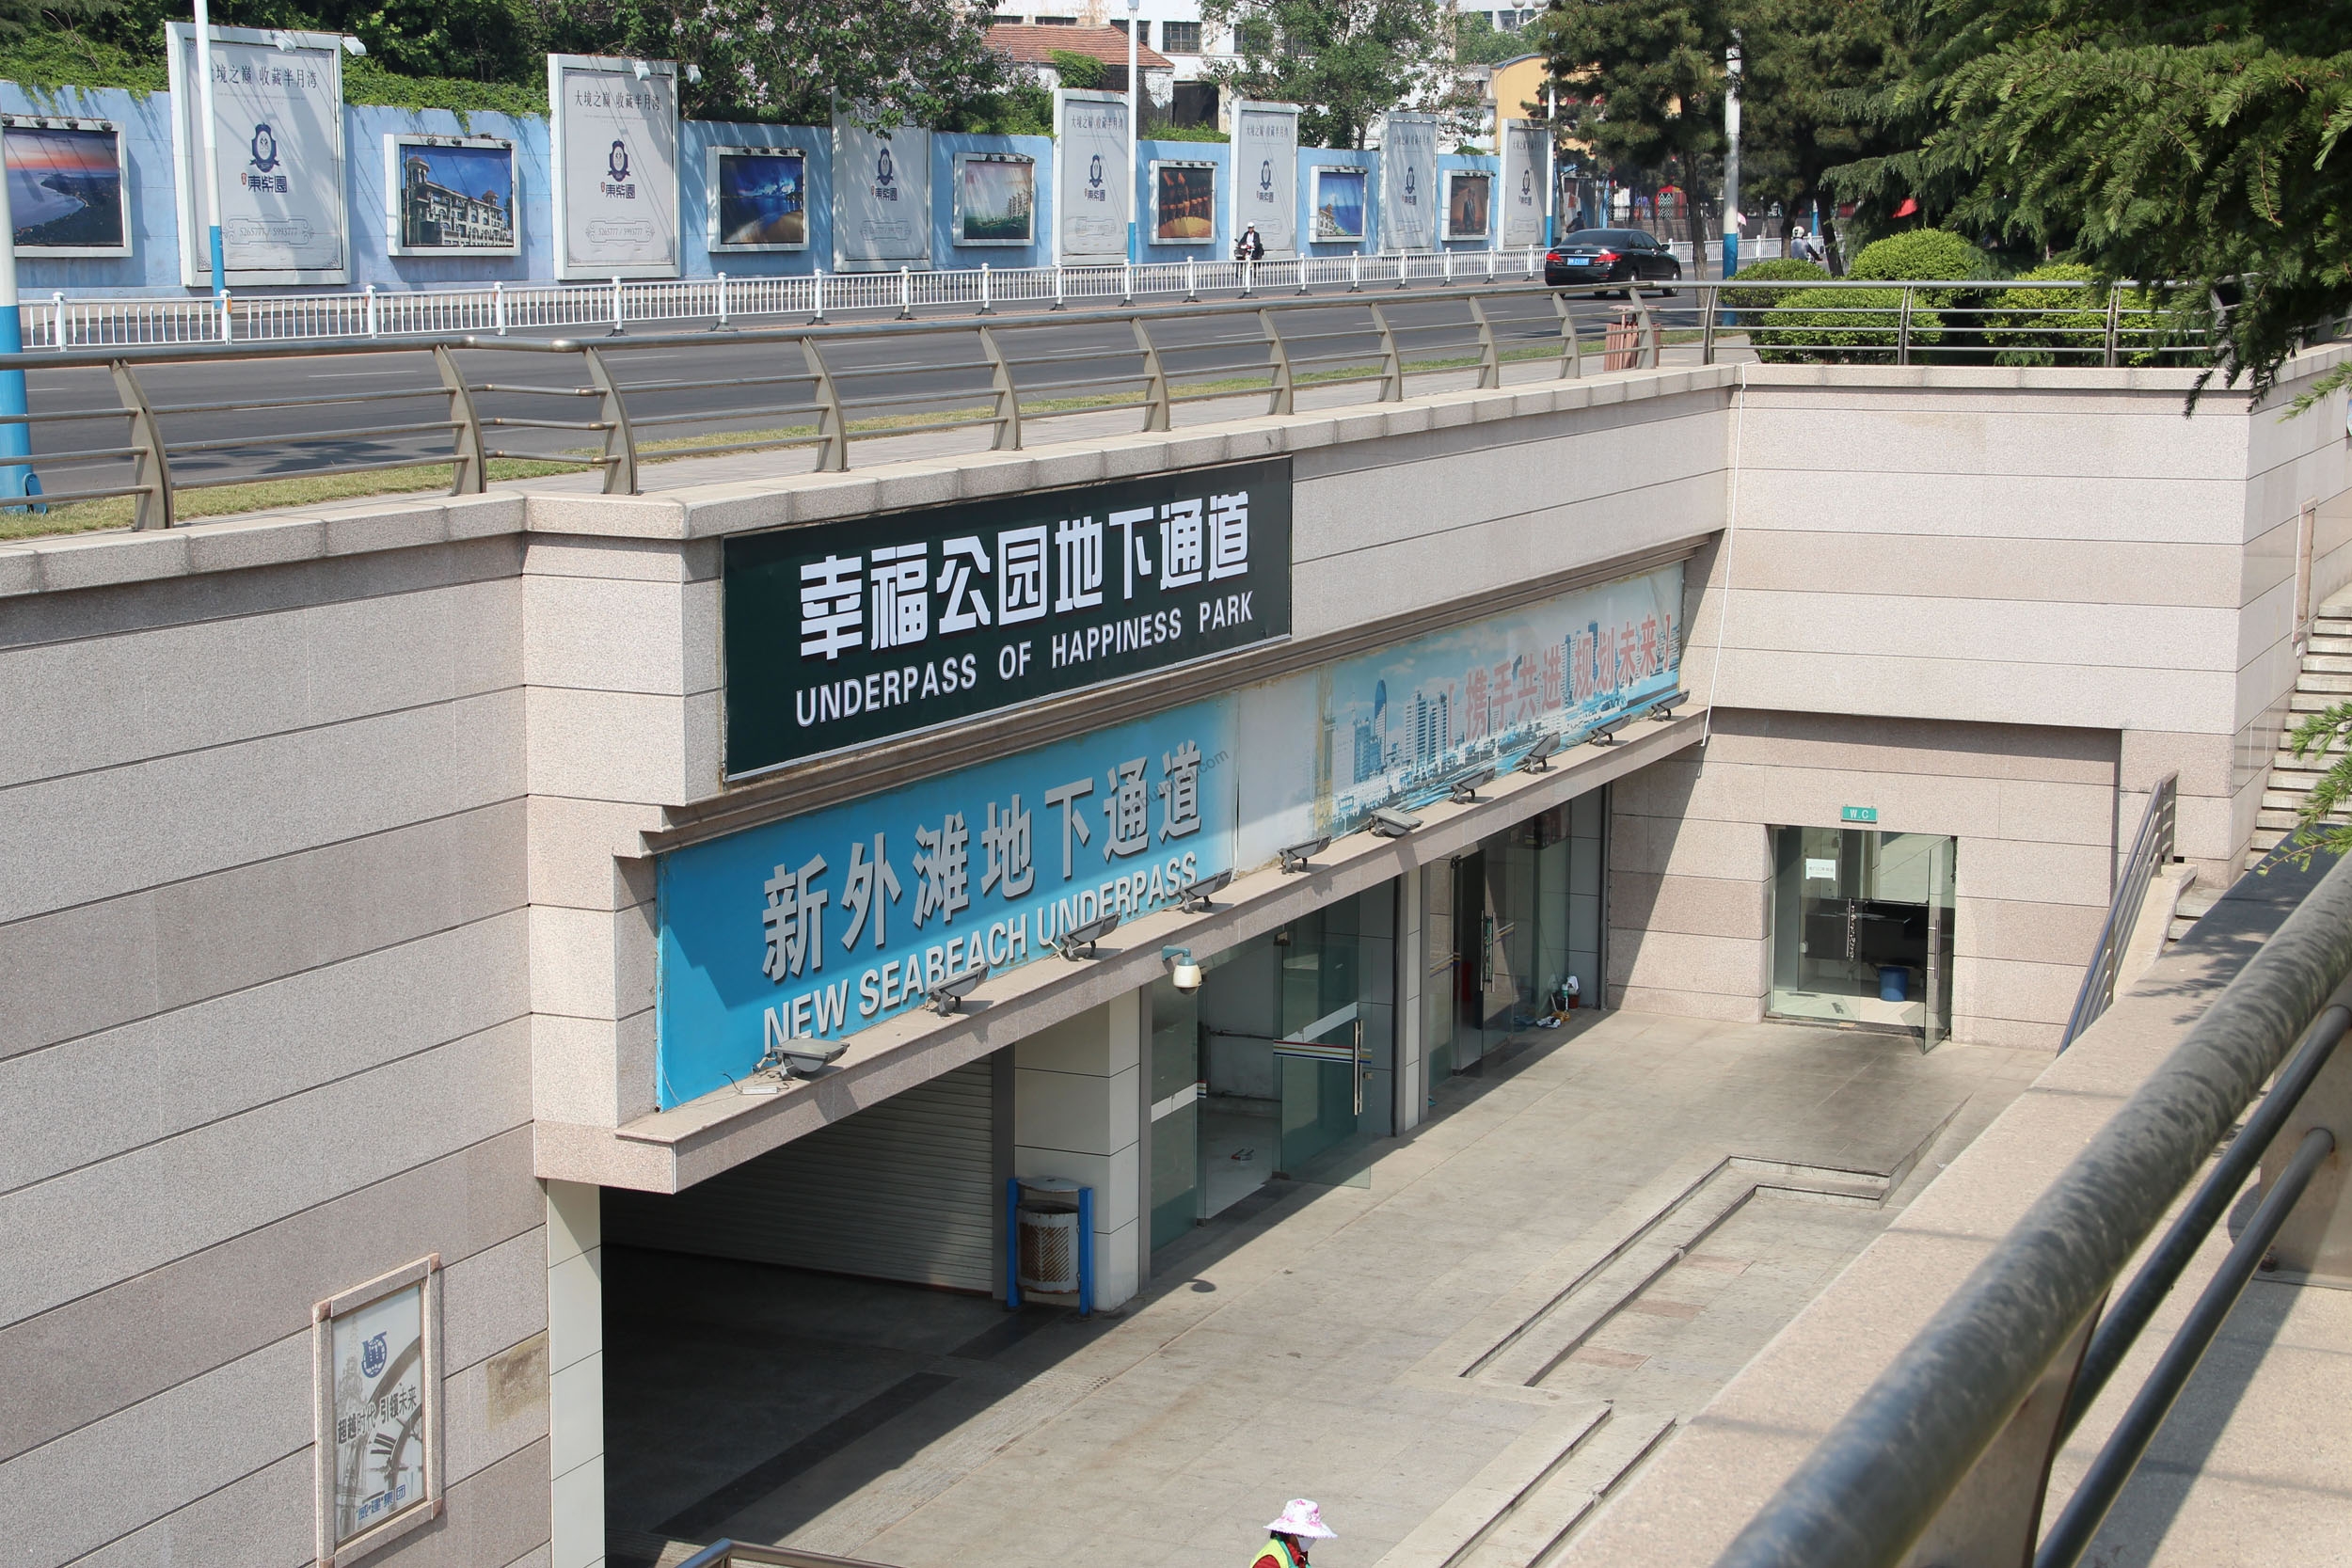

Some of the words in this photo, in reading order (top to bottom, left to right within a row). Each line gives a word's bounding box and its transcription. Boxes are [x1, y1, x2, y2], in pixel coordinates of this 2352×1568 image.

[211, 64, 253, 85] 境之巅
[259, 66, 318, 88] 收藏半月湾
[801, 491, 1249, 660] 幸福公园地下通道
[795, 654, 977, 728] UNDERPASS
[998, 641, 1032, 681] OF
[1052, 608, 1182, 669] HAPPINESS
[1199, 591, 1253, 634] PARK
[761, 739, 1202, 983] 新外滩地下通道
[764, 978, 849, 1055] NEW
[859, 912, 1027, 1016] SEABEACH
[1038, 850, 1197, 946] UNDERPASS
[338, 1403, 377, 1446] 超越时代
[380, 1384, 417, 1425] 引领未来
